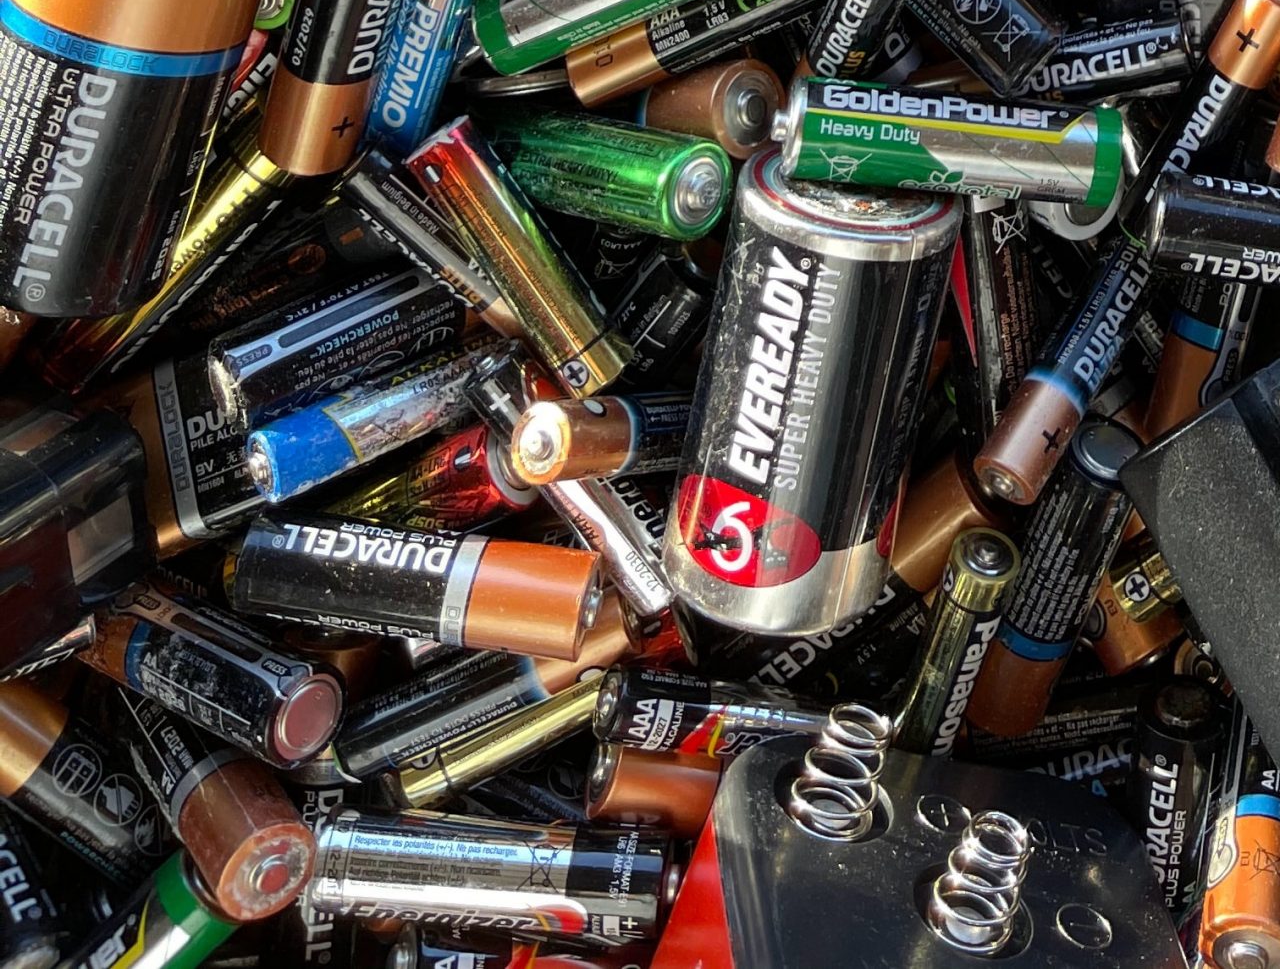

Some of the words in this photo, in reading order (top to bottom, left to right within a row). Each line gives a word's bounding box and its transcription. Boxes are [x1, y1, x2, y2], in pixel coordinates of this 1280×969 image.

[290, 7, 315, 66] 03/2029
[651, 19, 687, 41] Alkaline
[653, 29, 691, 53] MN2400
[382, 3, 439, 129] PREMIO
[40, 65, 82, 140] ULTRA
[820, 117, 875, 141] Heavy
[879, 123, 921, 145] Duty
[10, 140, 56, 226] POWER
[232, 344, 271, 367] PRESS
[773, 416, 807, 491] SUPER
[792, 332, 827, 414] HEAVY
[814, 262, 842, 327] DUTY
[342, 521, 404, 539] POWER
[406, 530, 456, 546] PLUS
[316, 613, 382, 630] POWER
[262, 658, 289, 677] PRESS
[931, 618, 996, 756] Panason
[628, 698, 659, 739] AAA
[1171, 809, 1188, 863] POWER
